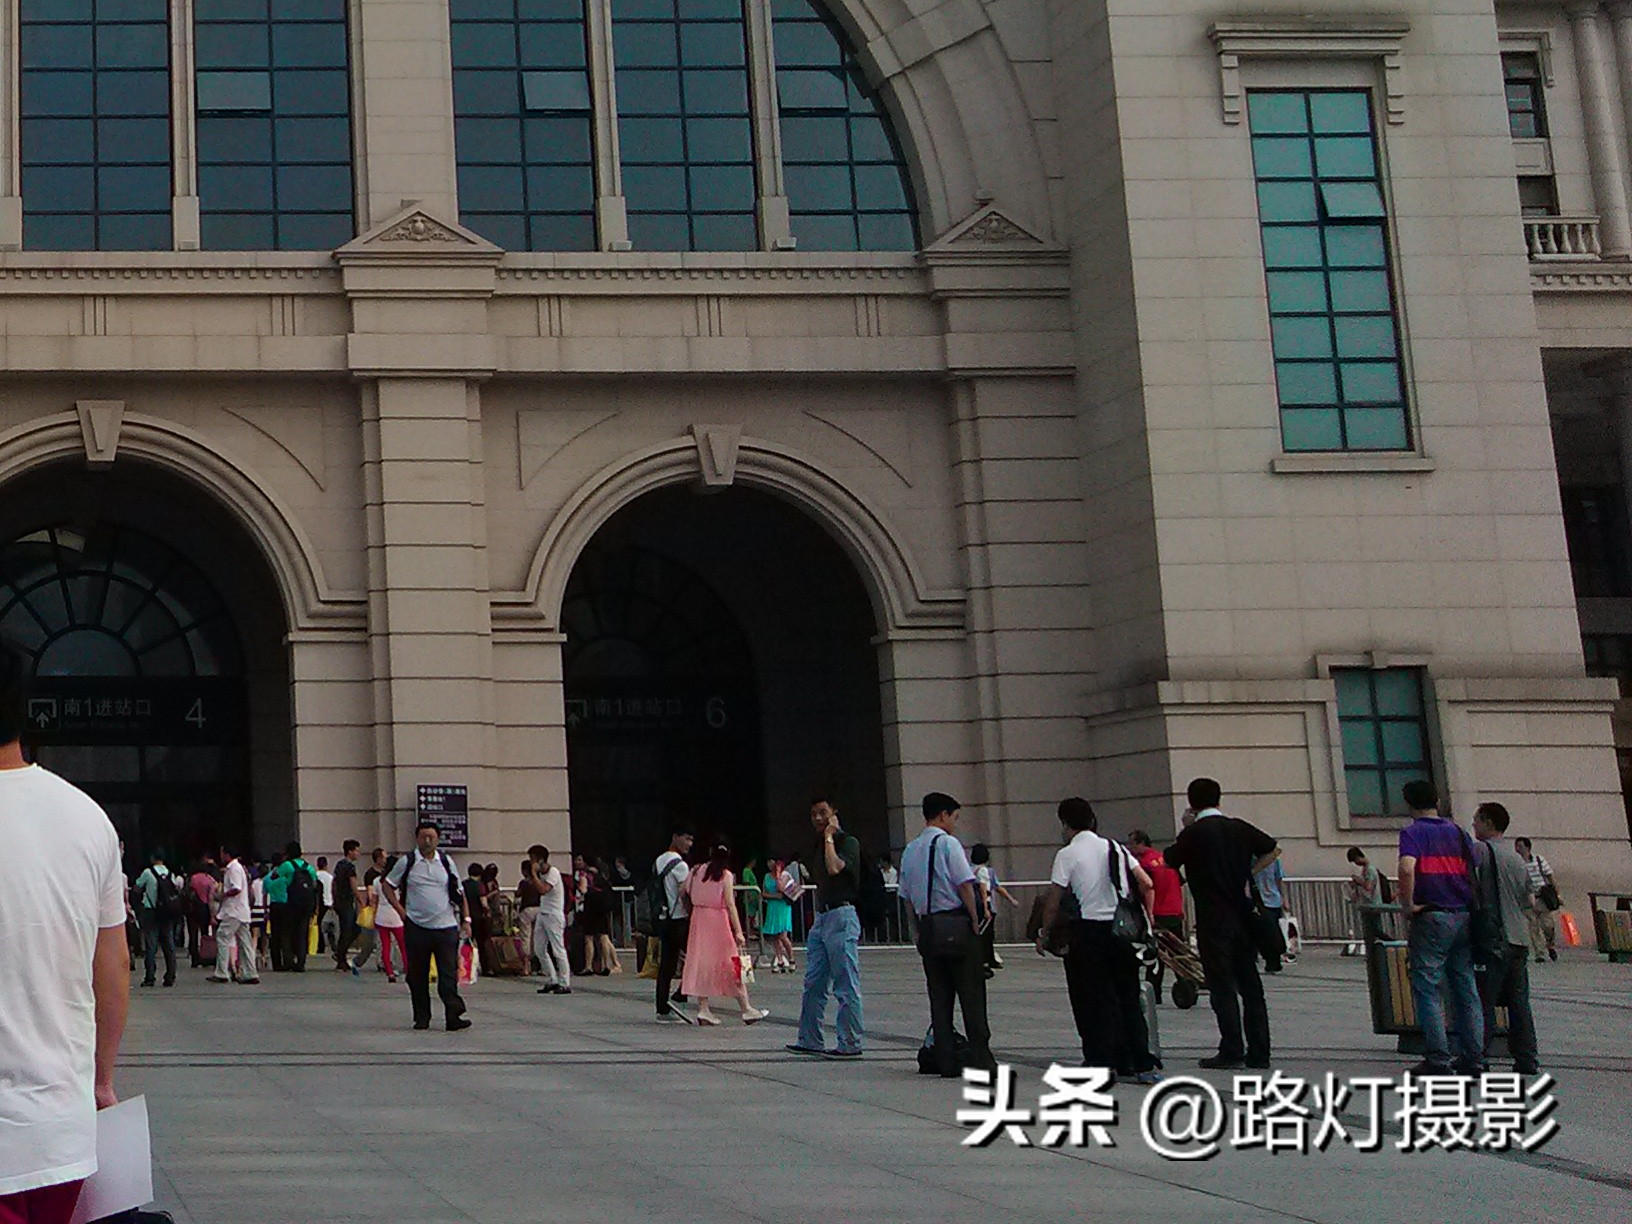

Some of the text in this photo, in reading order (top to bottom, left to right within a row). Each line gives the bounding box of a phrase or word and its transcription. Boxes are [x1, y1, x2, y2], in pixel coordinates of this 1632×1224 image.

[64, 697, 151, 717] 南1进站口
[185, 697, 207, 729] 4
[706, 696, 726, 728] 6
